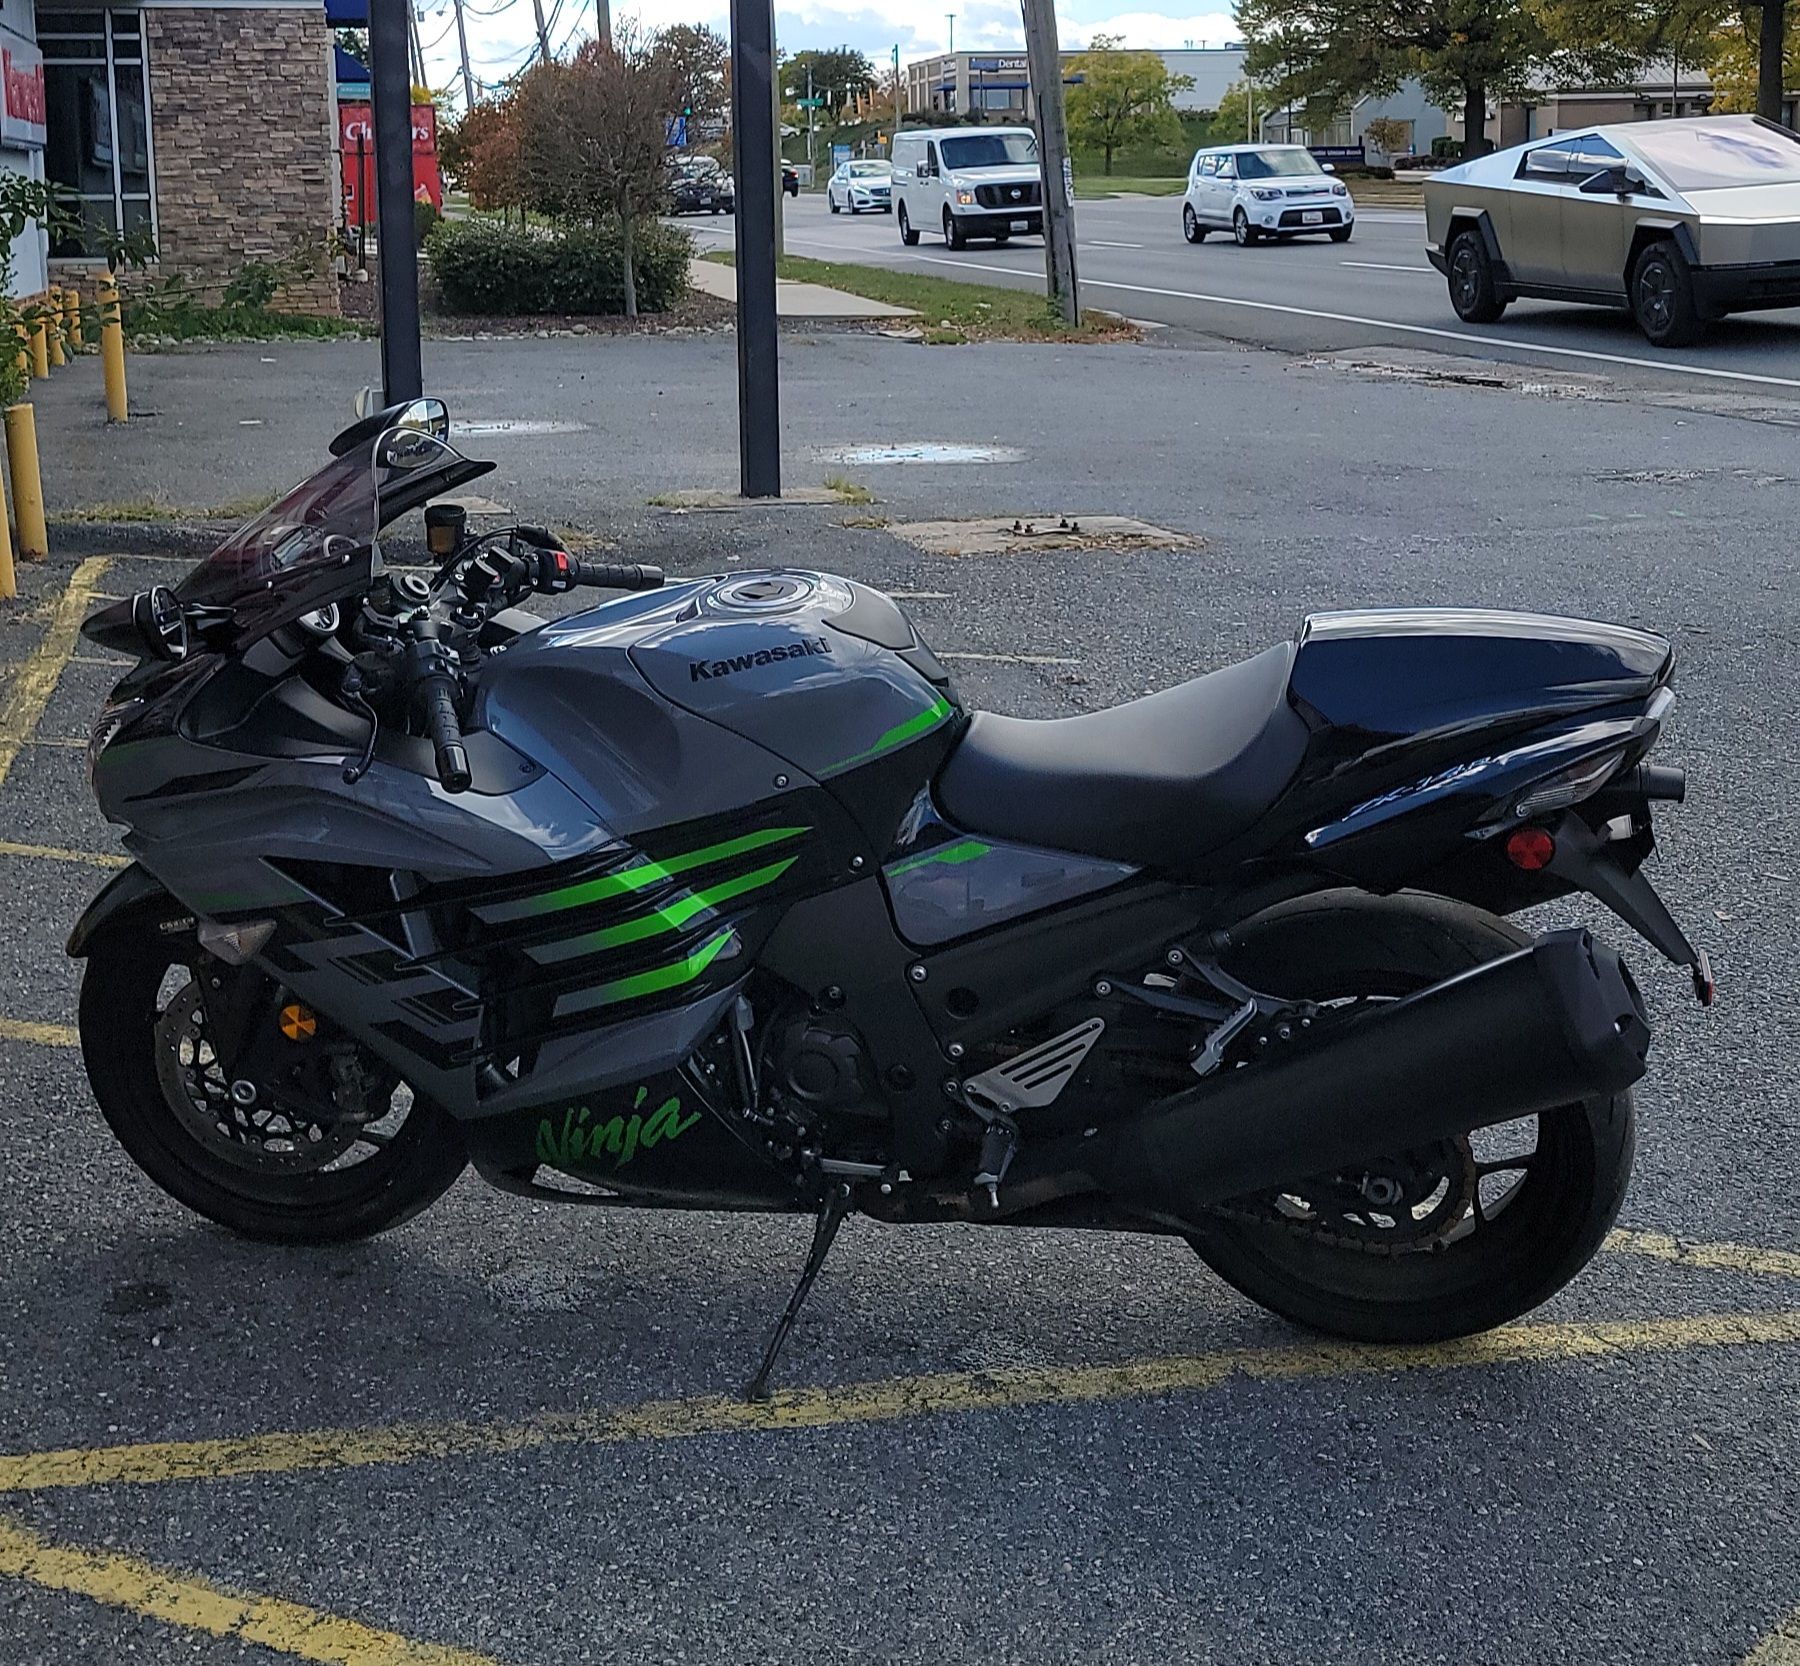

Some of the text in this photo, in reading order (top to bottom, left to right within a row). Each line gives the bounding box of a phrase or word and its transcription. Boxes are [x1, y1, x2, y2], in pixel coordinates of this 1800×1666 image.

[998, 59, 1026, 69] Dental
[345, 121, 429, 141] Chrs
[689, 637, 832, 682] Kawasaki
[536, 1086, 702, 1170] Ninja
